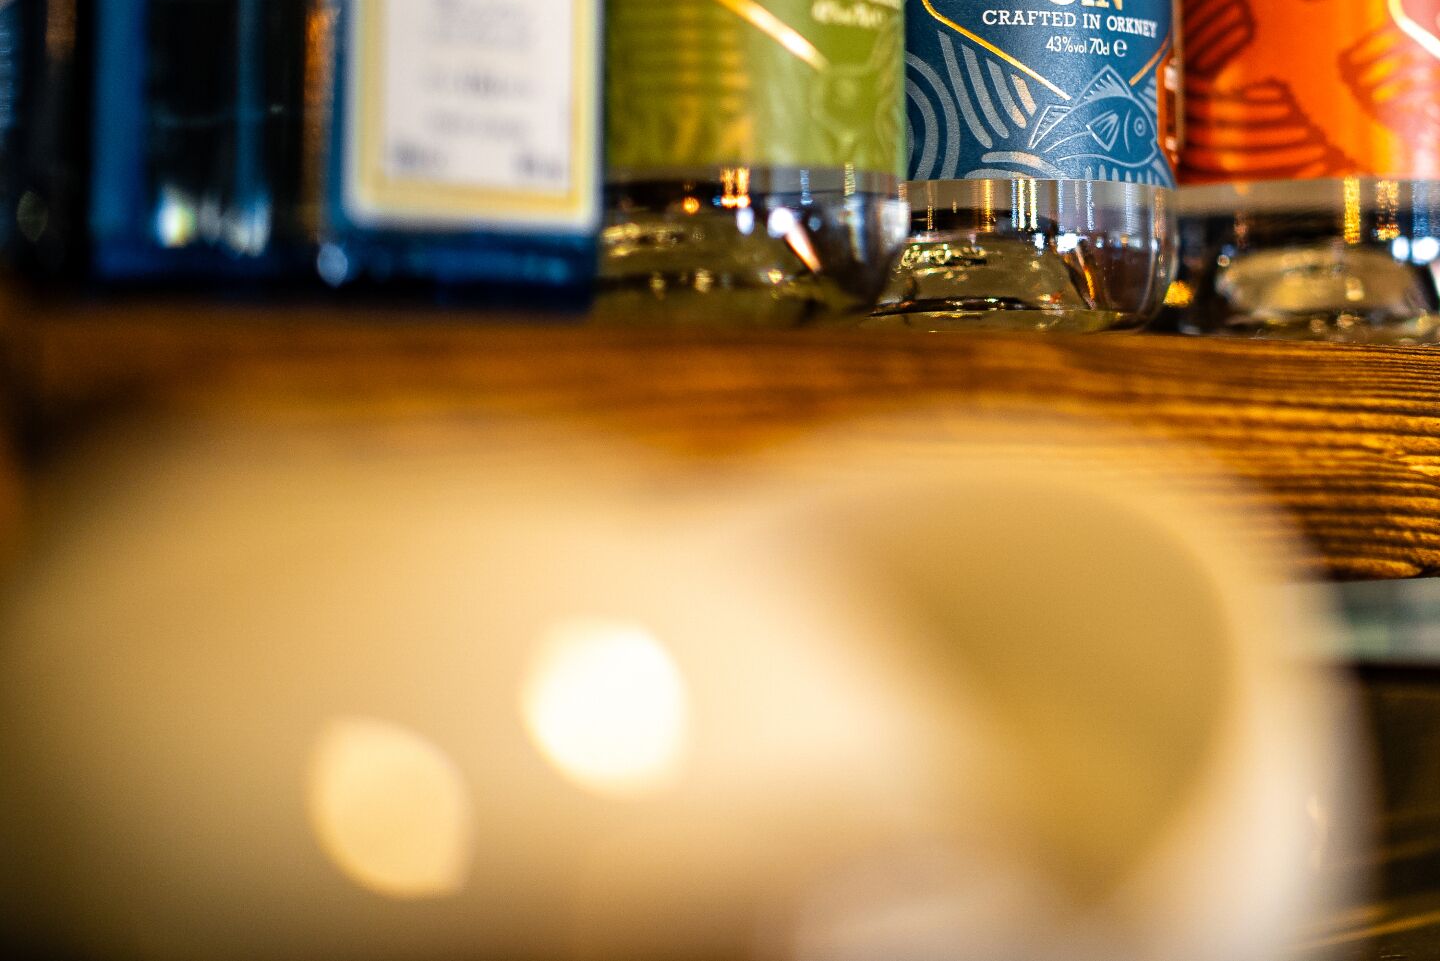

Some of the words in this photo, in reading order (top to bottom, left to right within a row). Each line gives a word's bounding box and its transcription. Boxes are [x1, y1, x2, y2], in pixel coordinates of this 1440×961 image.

[982, 9, 1077, 28] CRAFTED
[1083, 13, 1101, 29] IN
[1106, 13, 1158, 39] ORKNEY
